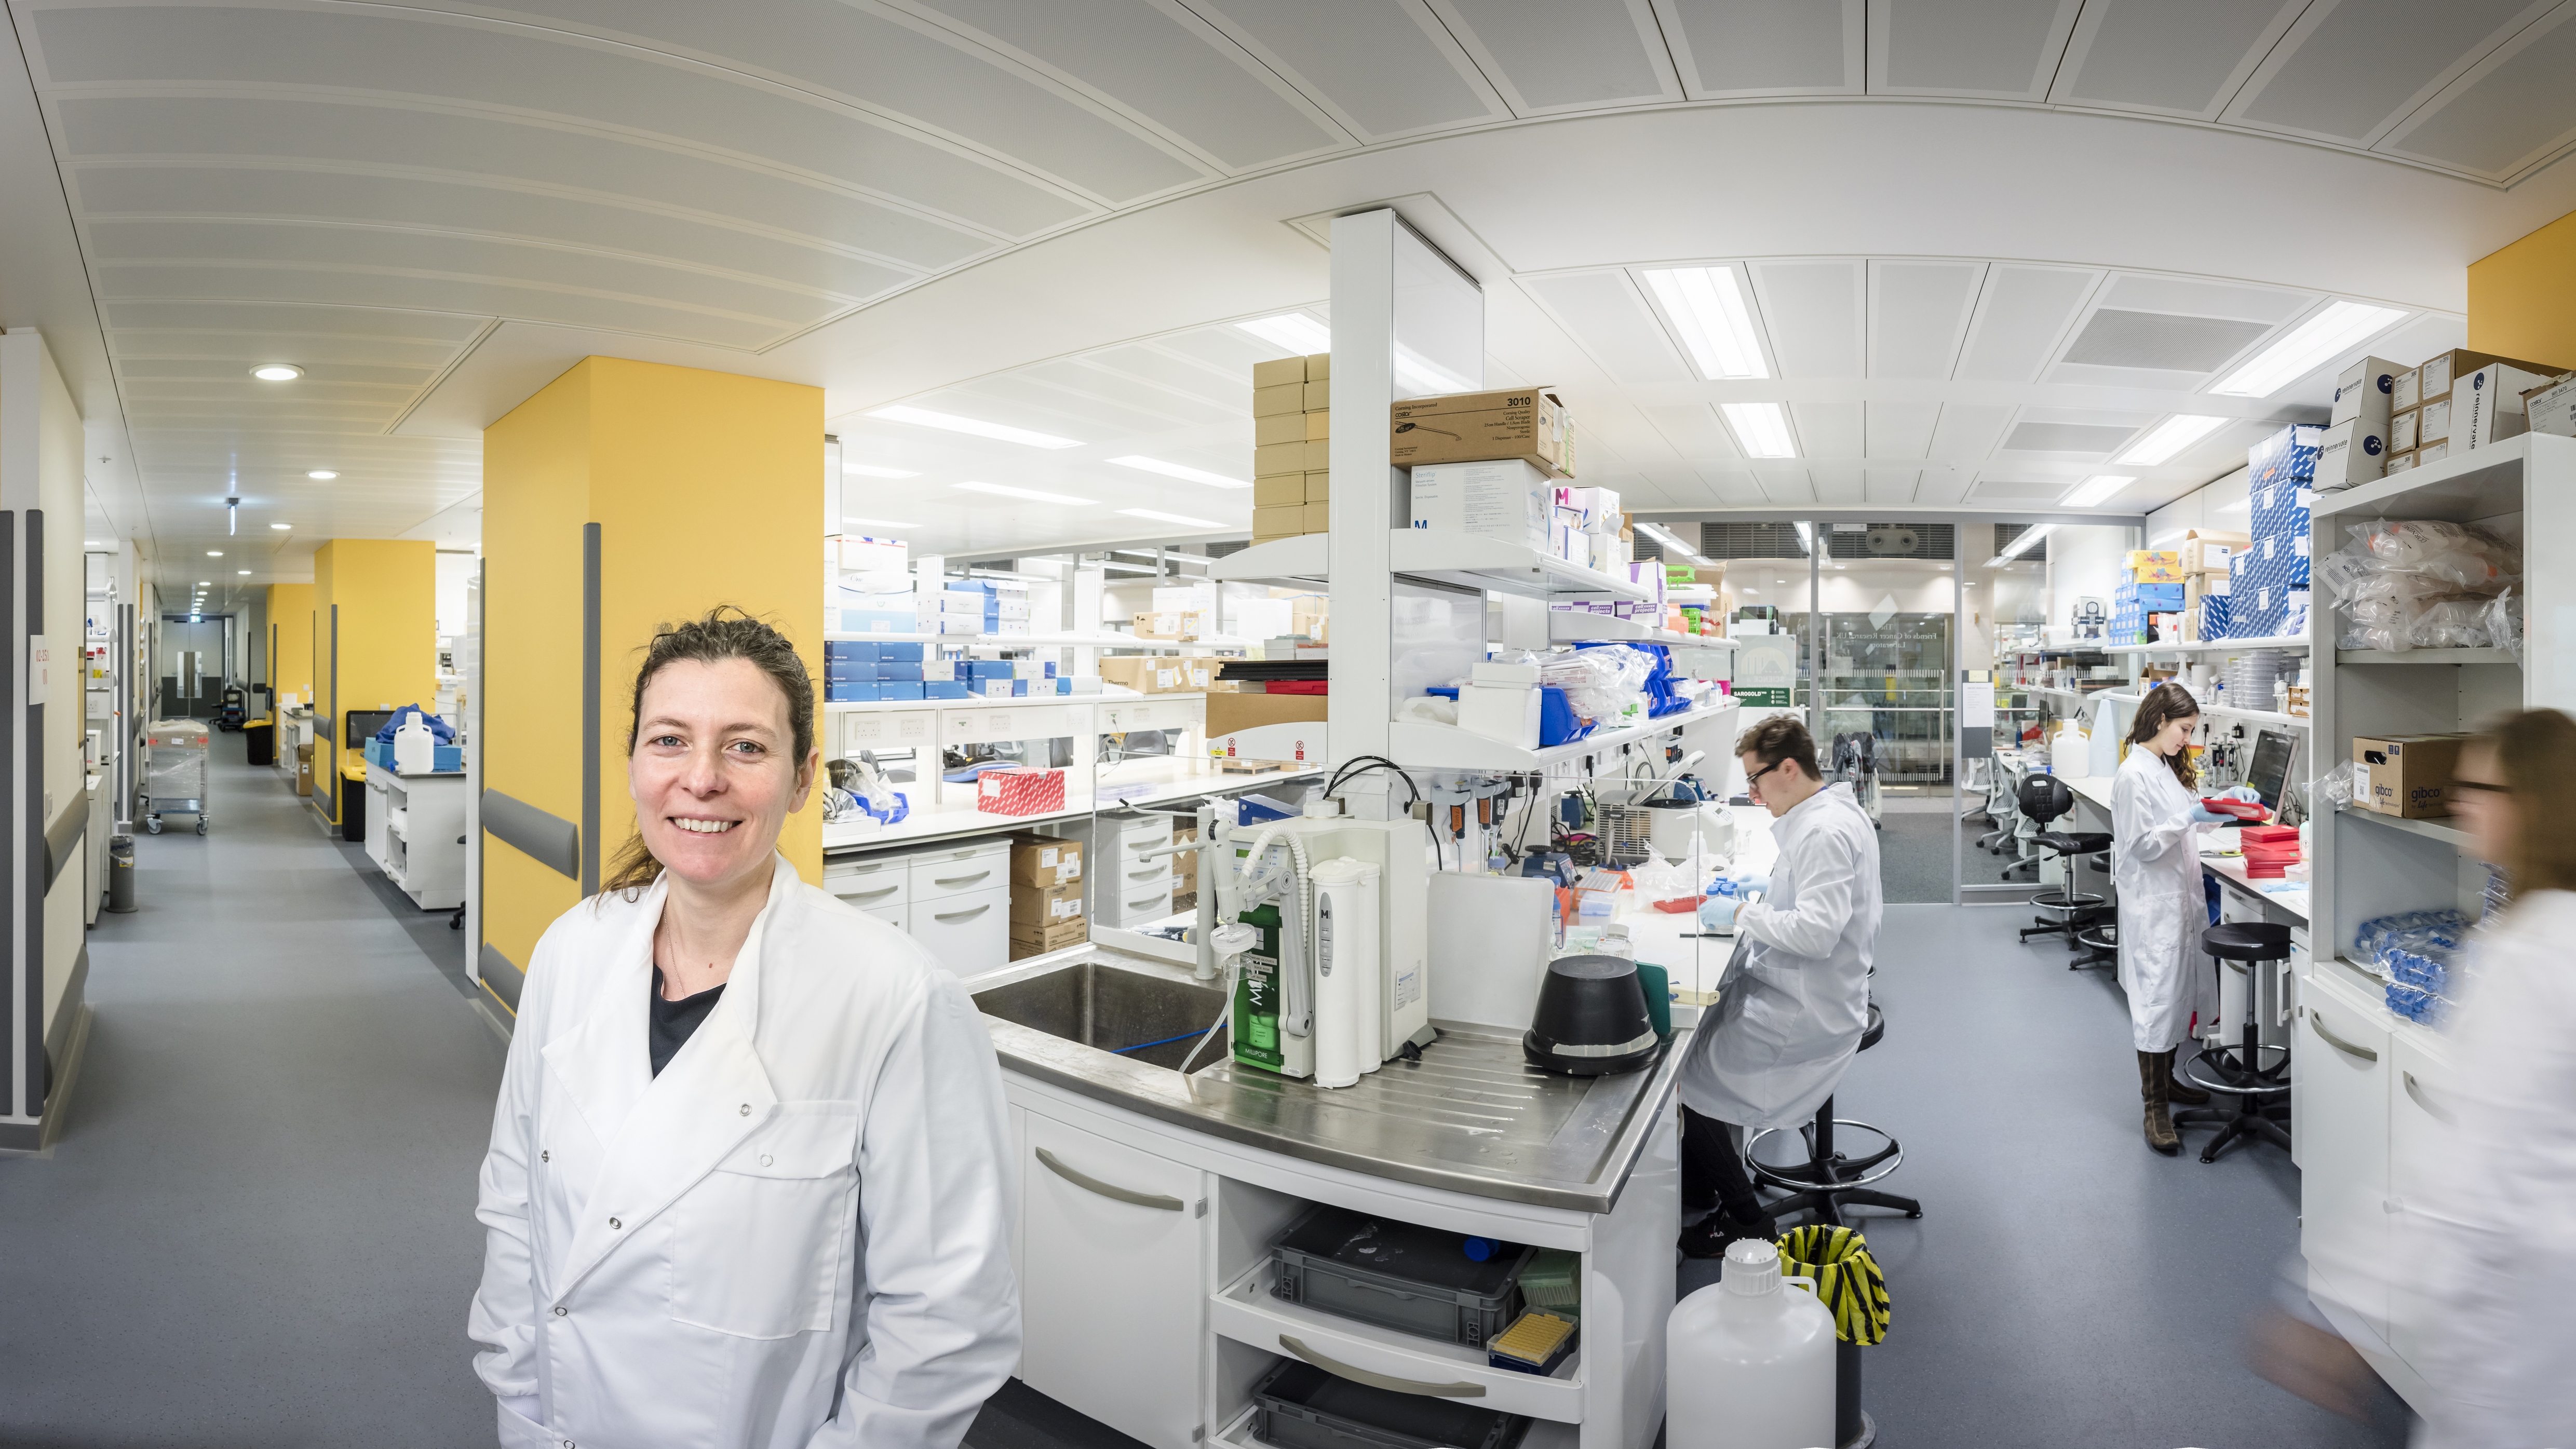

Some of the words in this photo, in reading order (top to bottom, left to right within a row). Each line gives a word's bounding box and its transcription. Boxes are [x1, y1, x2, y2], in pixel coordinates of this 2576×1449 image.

[2342, 378, 2362, 395] reinnervate
[1507, 397, 1530, 406] 3010
[2530, 398, 2542, 407] costar
[2471, 393, 2480, 450] reinnervate
[2324, 439, 2347, 453] reinnervate
[1555, 487, 1568, 505] M
[2375, 783, 2392, 797] gibco
[2411, 787, 2440, 802] gibco
[2418, 801, 2427, 811] life
[1321, 910, 1329, 919] M
[1245, 1048, 1267, 1059] MILLIPORE
[1710, 1230, 1724, 1238] FILA
